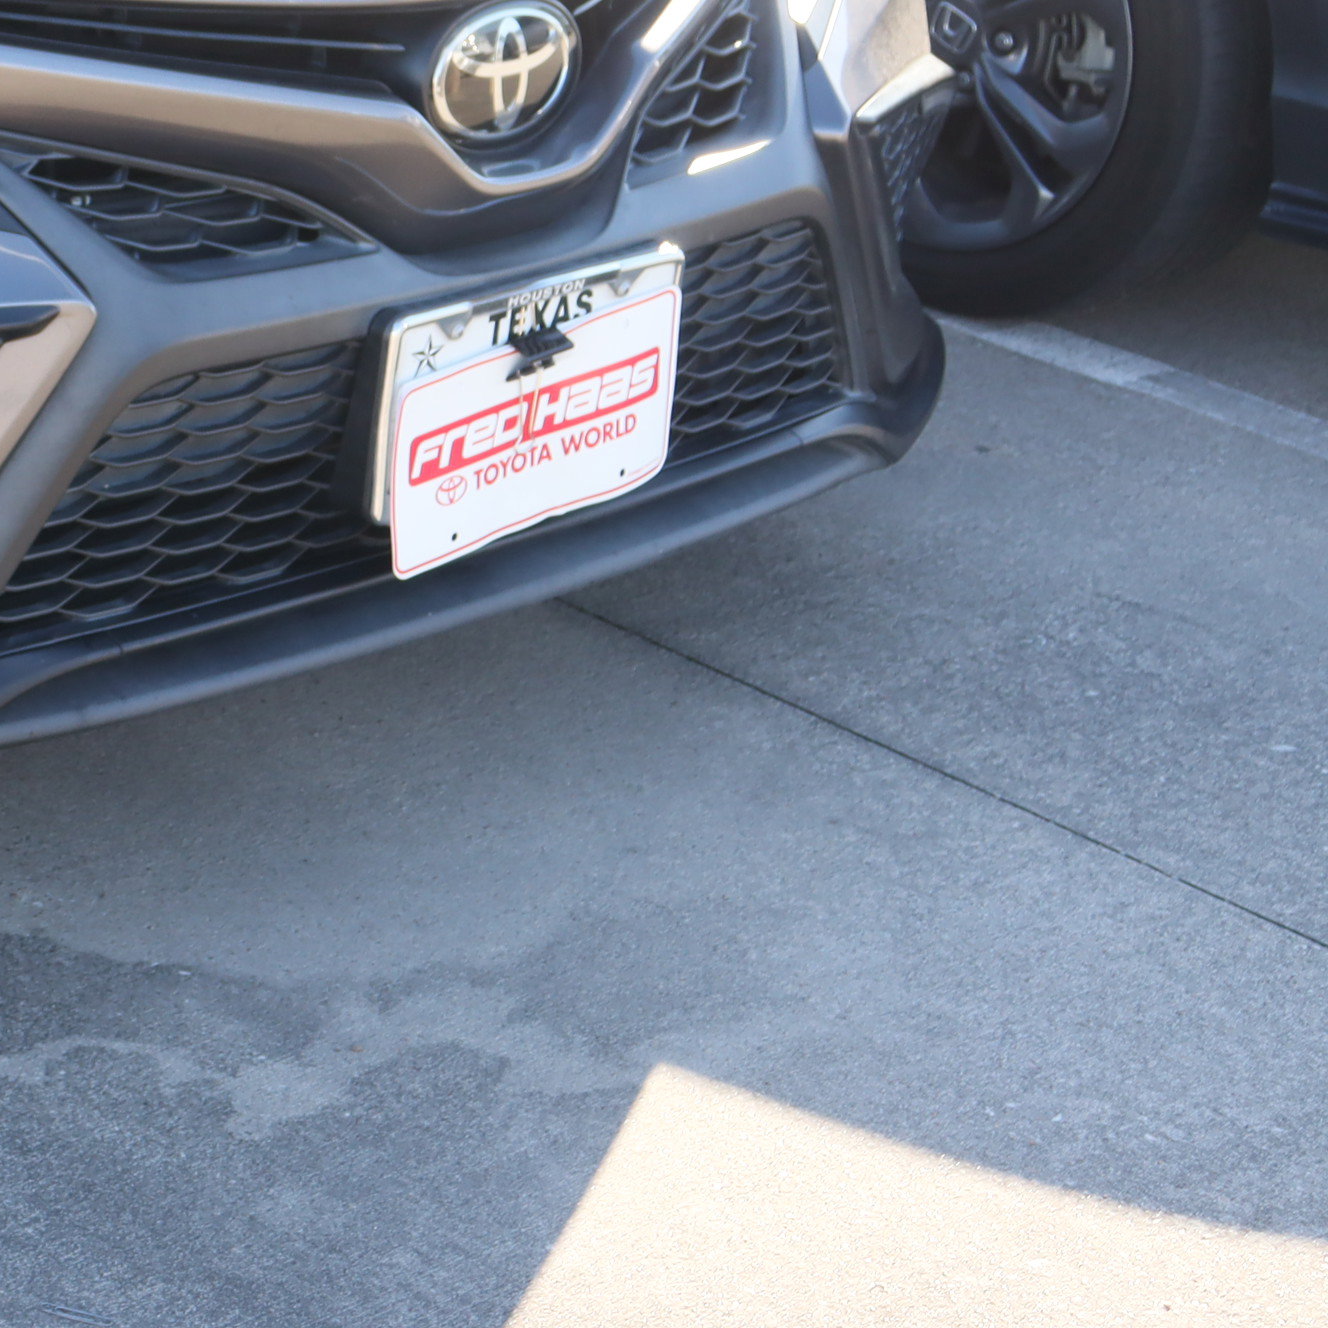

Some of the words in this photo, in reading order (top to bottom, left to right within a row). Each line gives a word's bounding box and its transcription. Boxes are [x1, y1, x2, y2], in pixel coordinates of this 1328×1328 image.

[489, 288, 593, 346] TEXAS
[507, 278, 586, 309] HOUSTON
[473, 442, 552, 490] TOYOTA
[560, 413, 637, 456] WORLD
